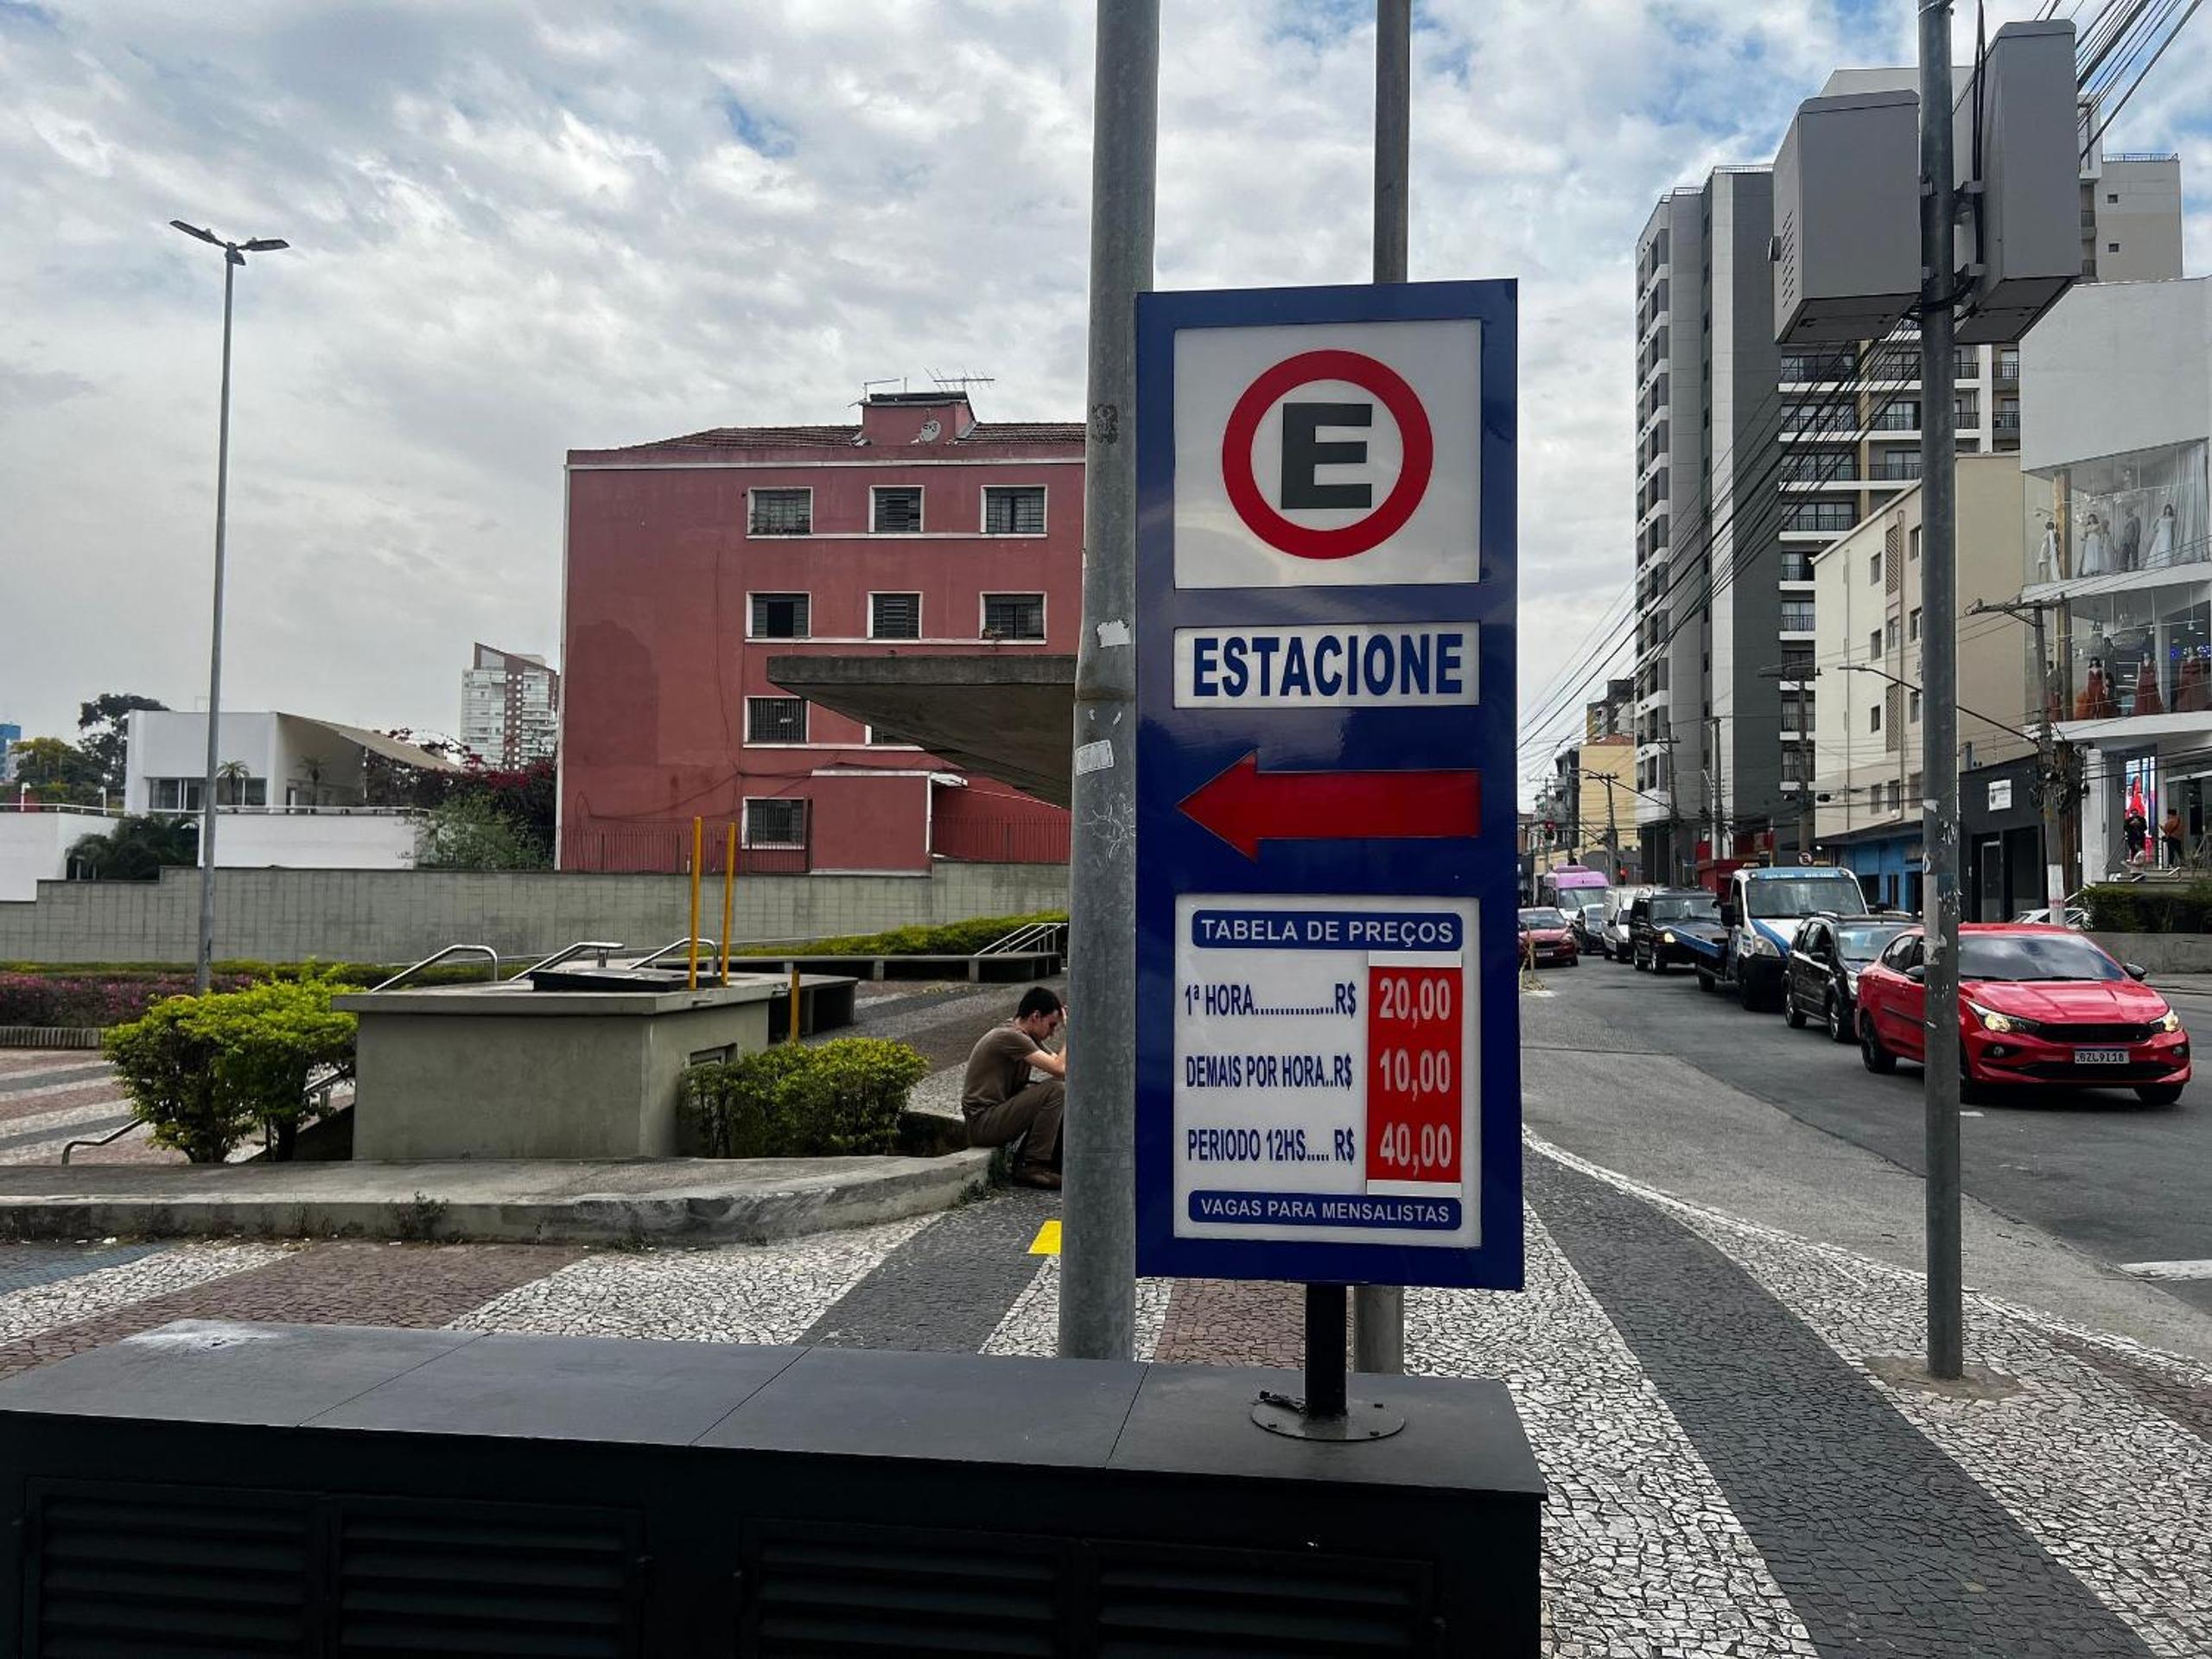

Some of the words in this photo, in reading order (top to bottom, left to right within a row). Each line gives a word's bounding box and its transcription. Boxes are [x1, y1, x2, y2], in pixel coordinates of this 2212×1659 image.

[1281, 403, 1373, 509] E
[1194, 633, 1463, 697] ESTACIONE
[1201, 920, 1298, 940] TABELA
[1308, 921, 1338, 941] DE
[1350, 922, 1452, 947] PREÇOS
[1380, 978, 1450, 1028] 20,00
[1186, 1056, 1242, 1087] DEMAIS
[1247, 1056, 1277, 1087] POR
[1380, 1050, 1450, 1101] 10,00
[1188, 1129, 1260, 1161] PERIODO
[1335, 1128, 1354, 1165] R$
[1380, 1123, 1452, 1175] 40,00
[1201, 1199, 1261, 1216] VAGAS
[1268, 1201, 1316, 1217] PARA
[1323, 1203, 1448, 1222] MENSALISTAS
